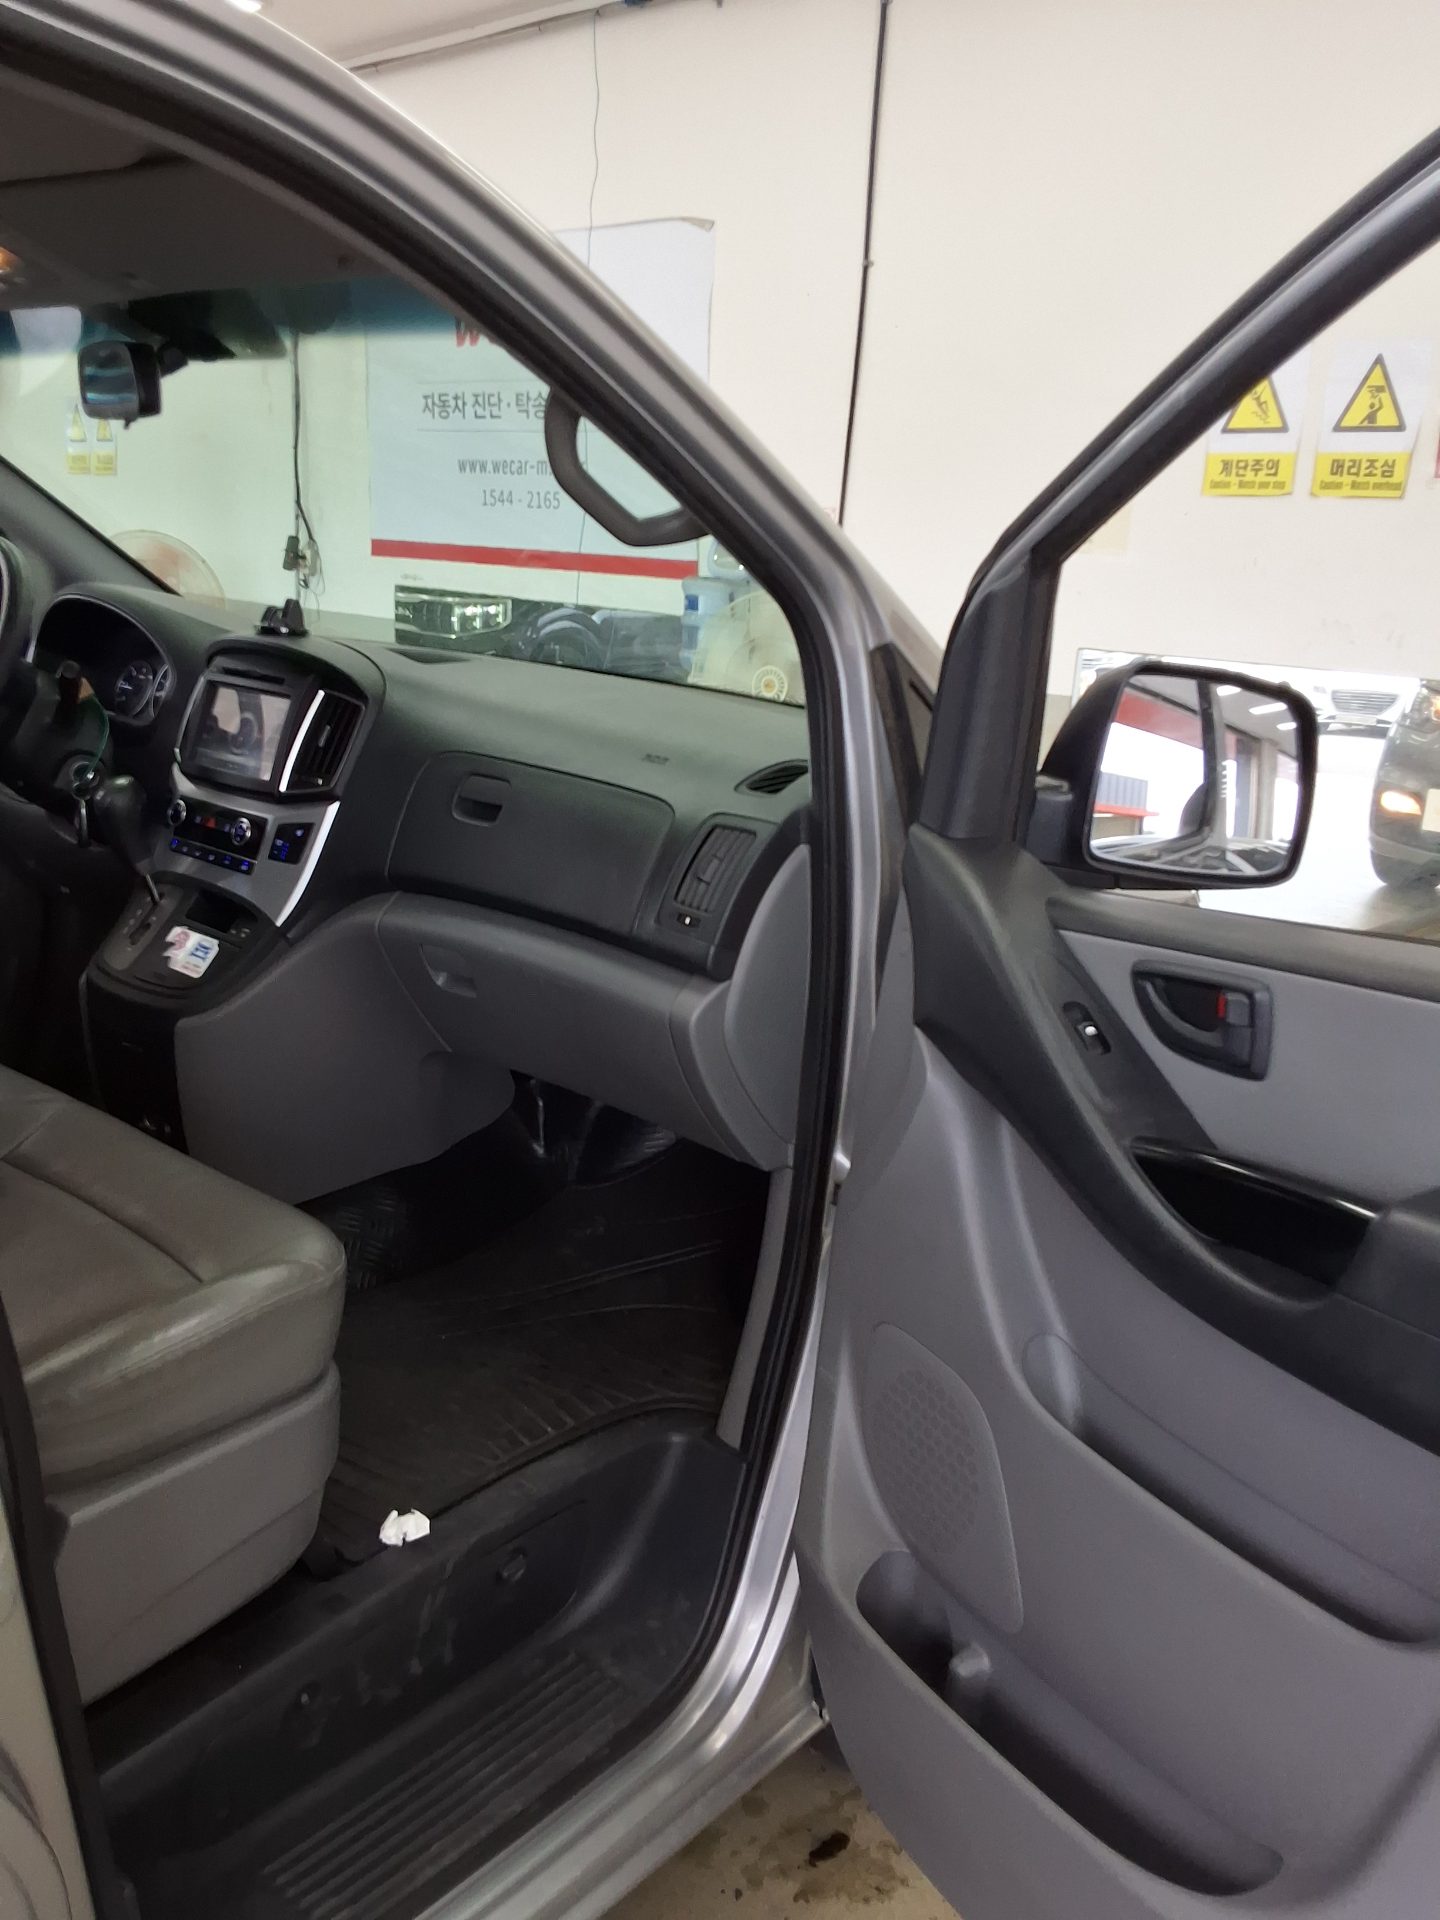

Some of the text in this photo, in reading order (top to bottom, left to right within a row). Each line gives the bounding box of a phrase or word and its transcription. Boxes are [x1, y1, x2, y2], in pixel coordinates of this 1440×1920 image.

[421, 391, 467, 420] 자동차
[1218, 458, 1281, 478] 계단주의
[1329, 457, 1397, 479] 머리조심
[482, 488, 514, 507] 1544
[527, 490, 561, 510] 2165
